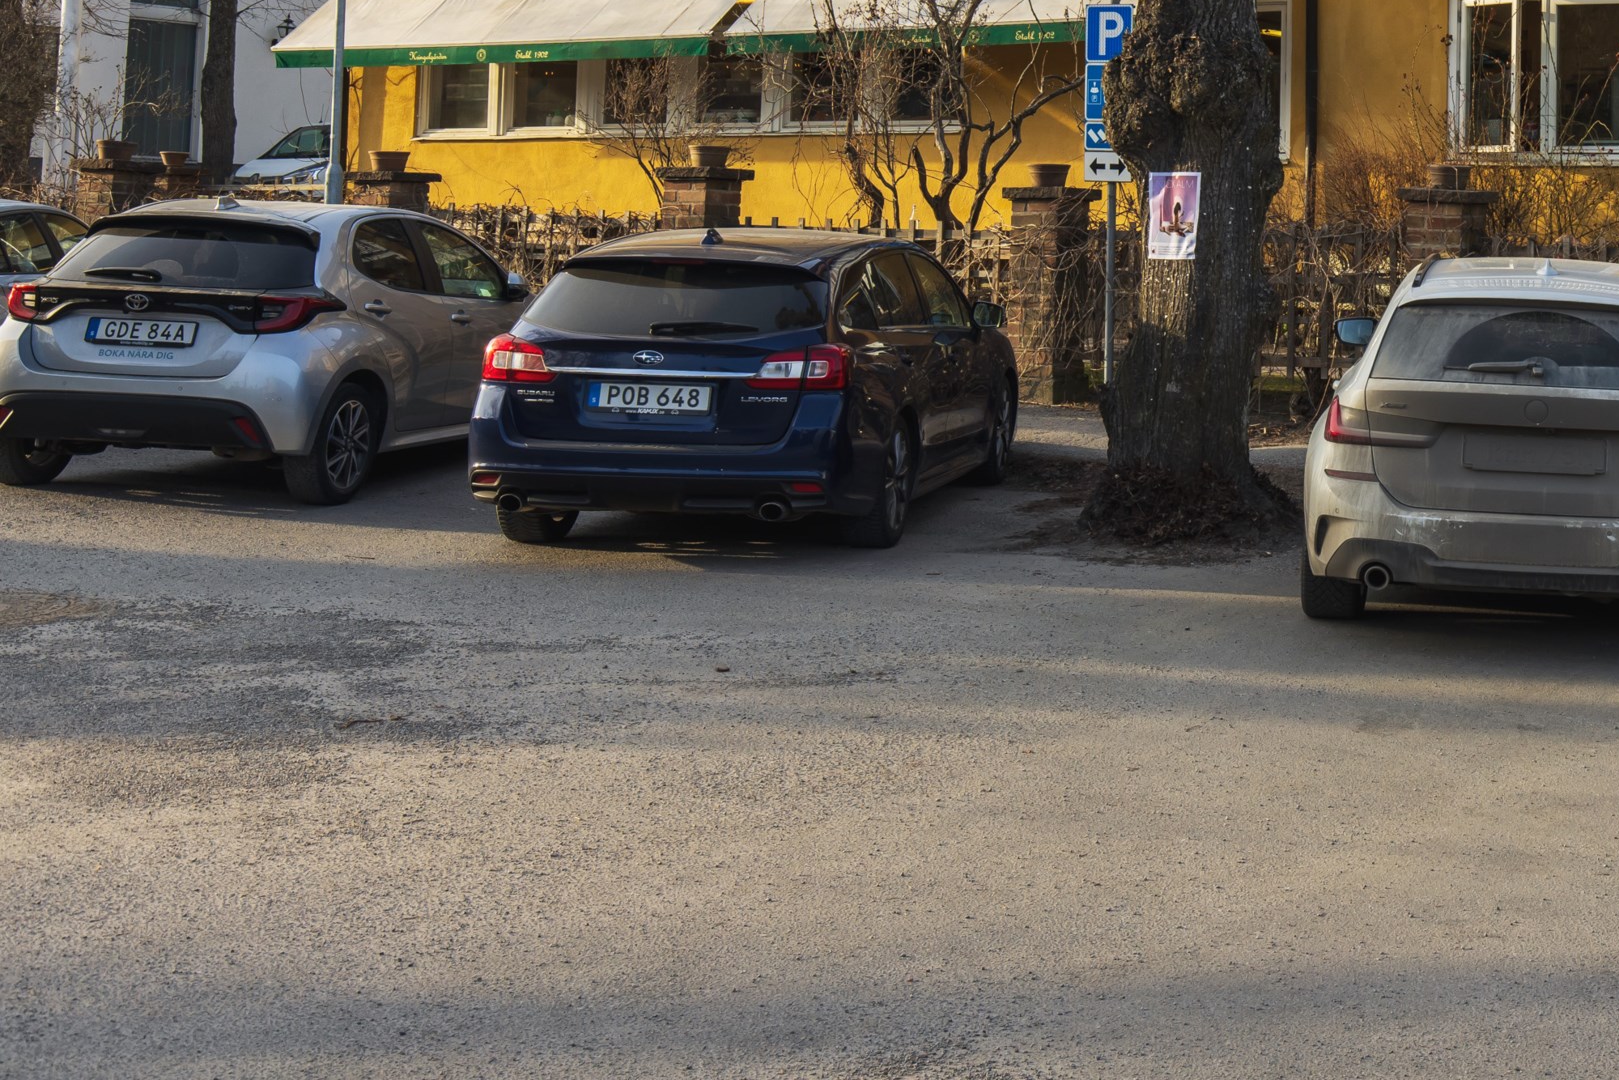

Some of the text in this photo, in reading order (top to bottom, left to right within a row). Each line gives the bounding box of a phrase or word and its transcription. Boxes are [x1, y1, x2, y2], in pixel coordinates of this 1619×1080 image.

[1098, 11, 1124, 56] P
[534, 51, 549, 59] 1902
[105, 321, 185, 341] GDE 84A
[98, 348, 174, 360] BOKA NÄRA DIG
[517, 389, 555, 397] SUBARU
[606, 385, 700, 408] POB 648
